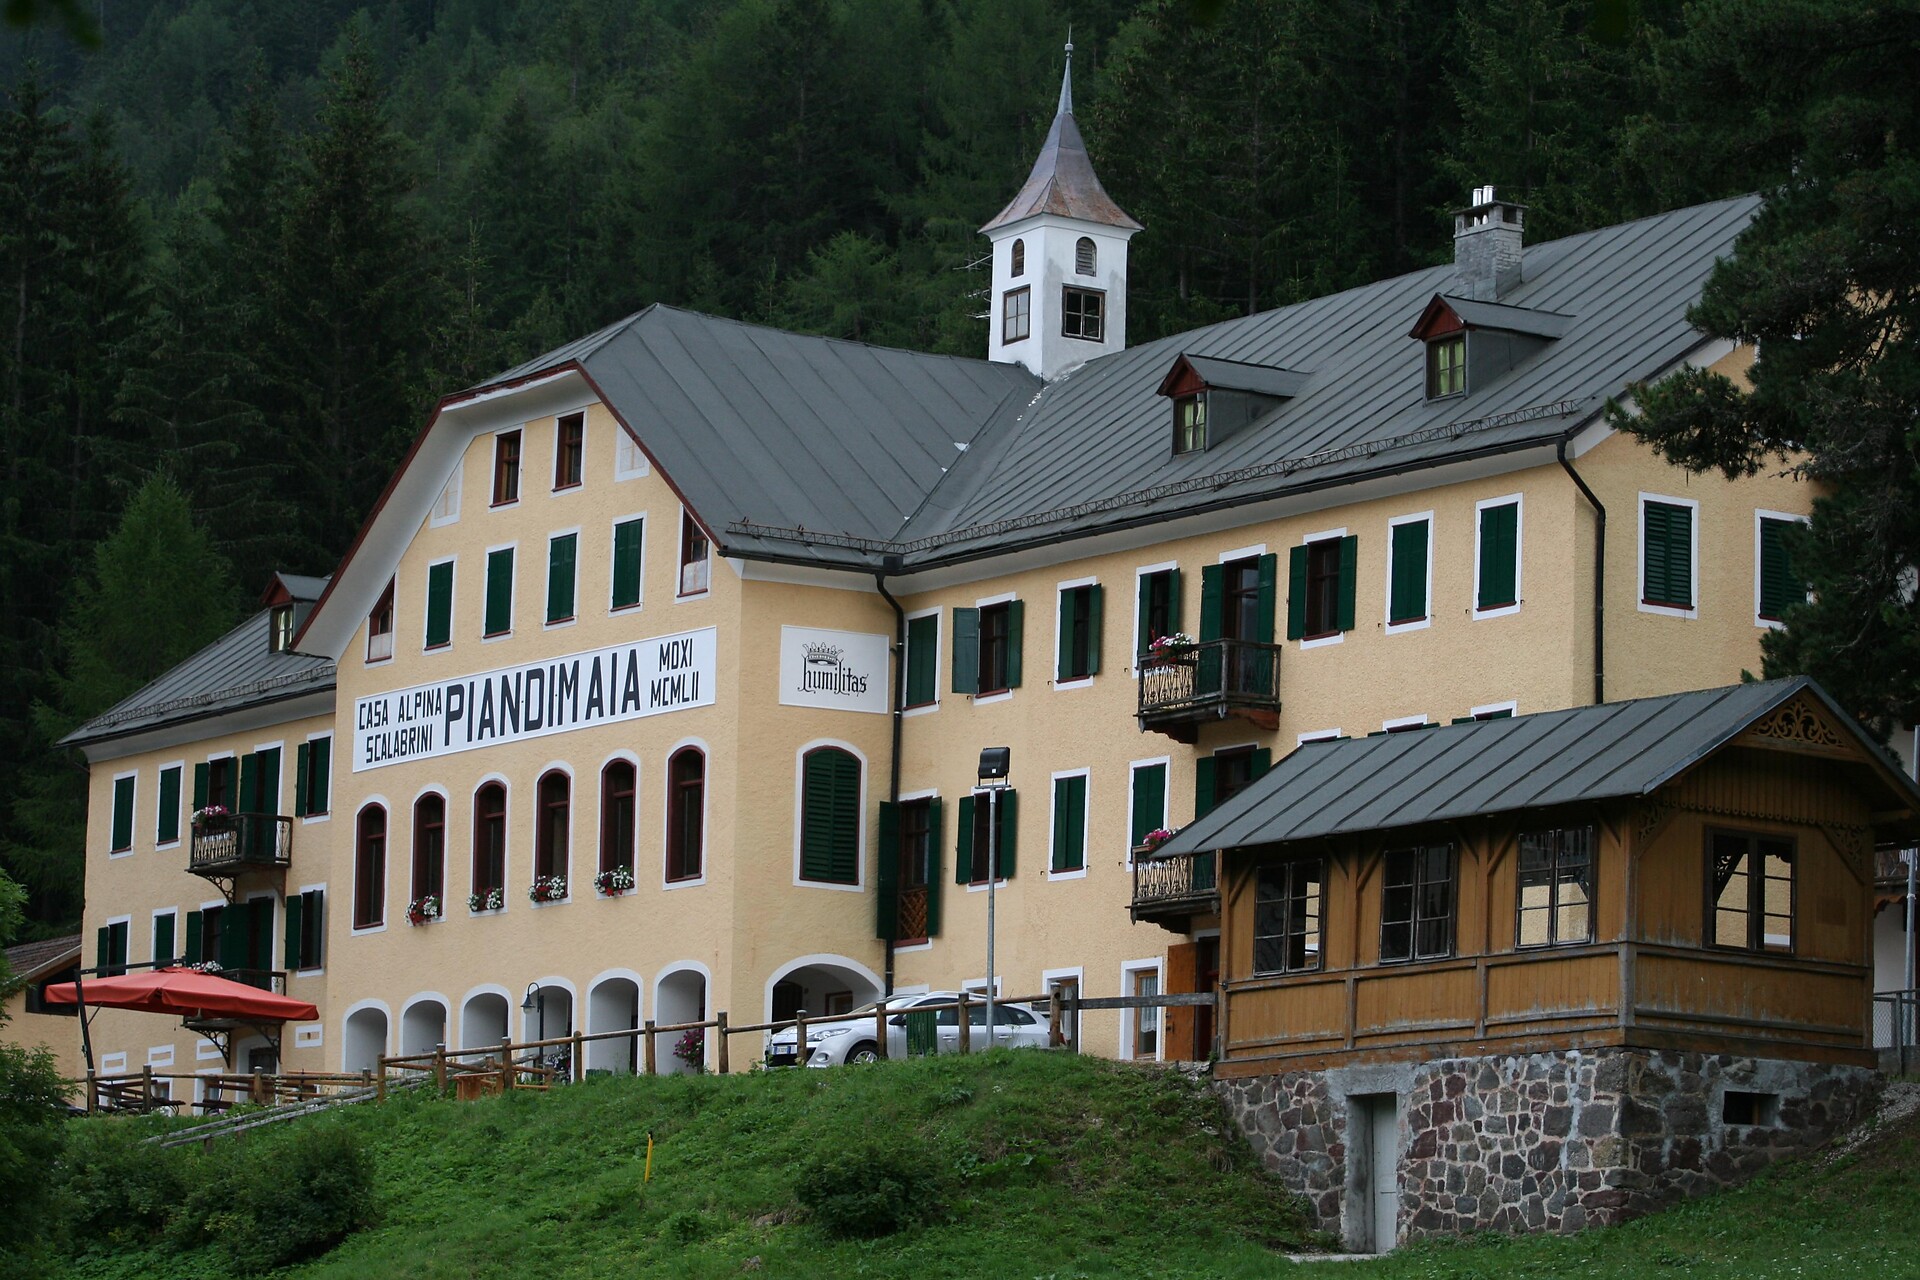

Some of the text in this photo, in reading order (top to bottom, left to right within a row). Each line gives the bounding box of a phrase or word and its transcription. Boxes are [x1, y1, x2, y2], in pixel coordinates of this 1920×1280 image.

[659, 638, 693, 672] MDXI
[358, 687, 442, 730] CASA ALPINA
[650, 671, 699, 708] MCMLII
[366, 723, 433, 764] SCALABRINI
